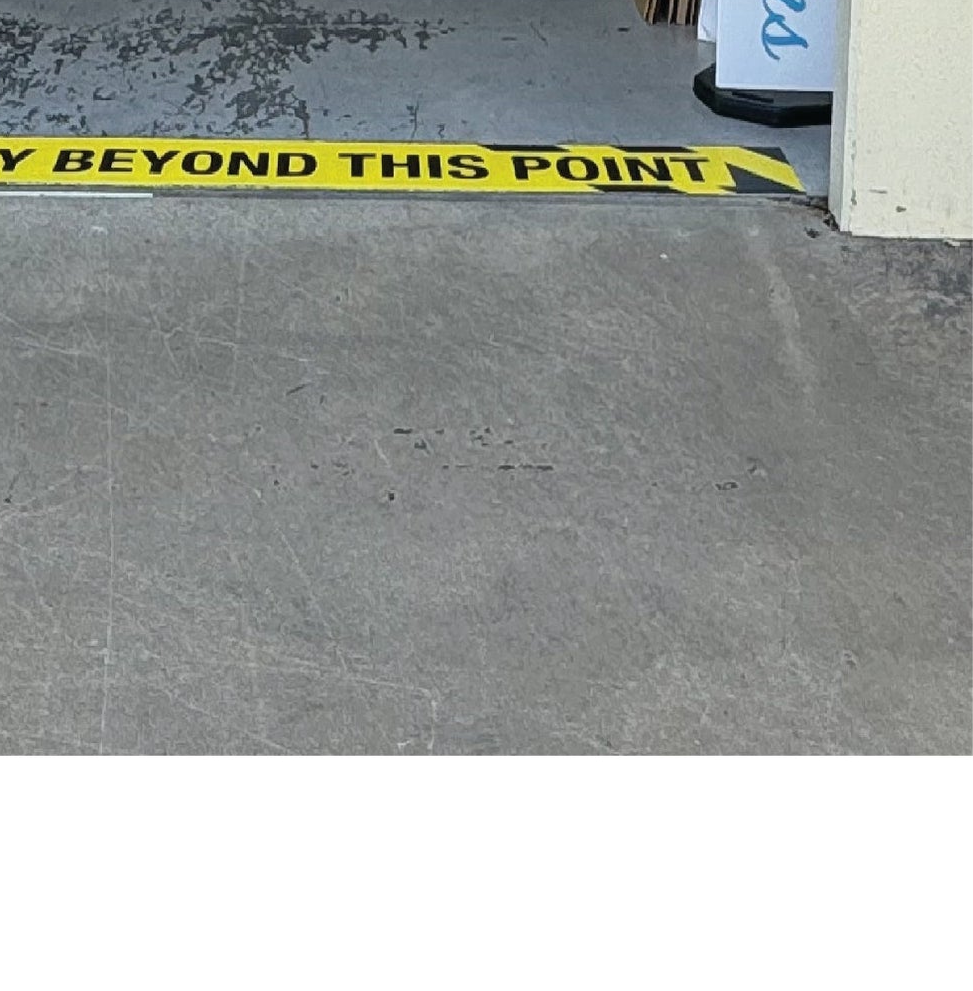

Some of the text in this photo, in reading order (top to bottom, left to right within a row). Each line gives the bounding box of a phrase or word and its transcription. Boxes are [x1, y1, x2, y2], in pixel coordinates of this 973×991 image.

[52, 149, 318, 178] BEYOND
[338, 152, 489, 180] THIS
[512, 156, 710, 183] POINT
